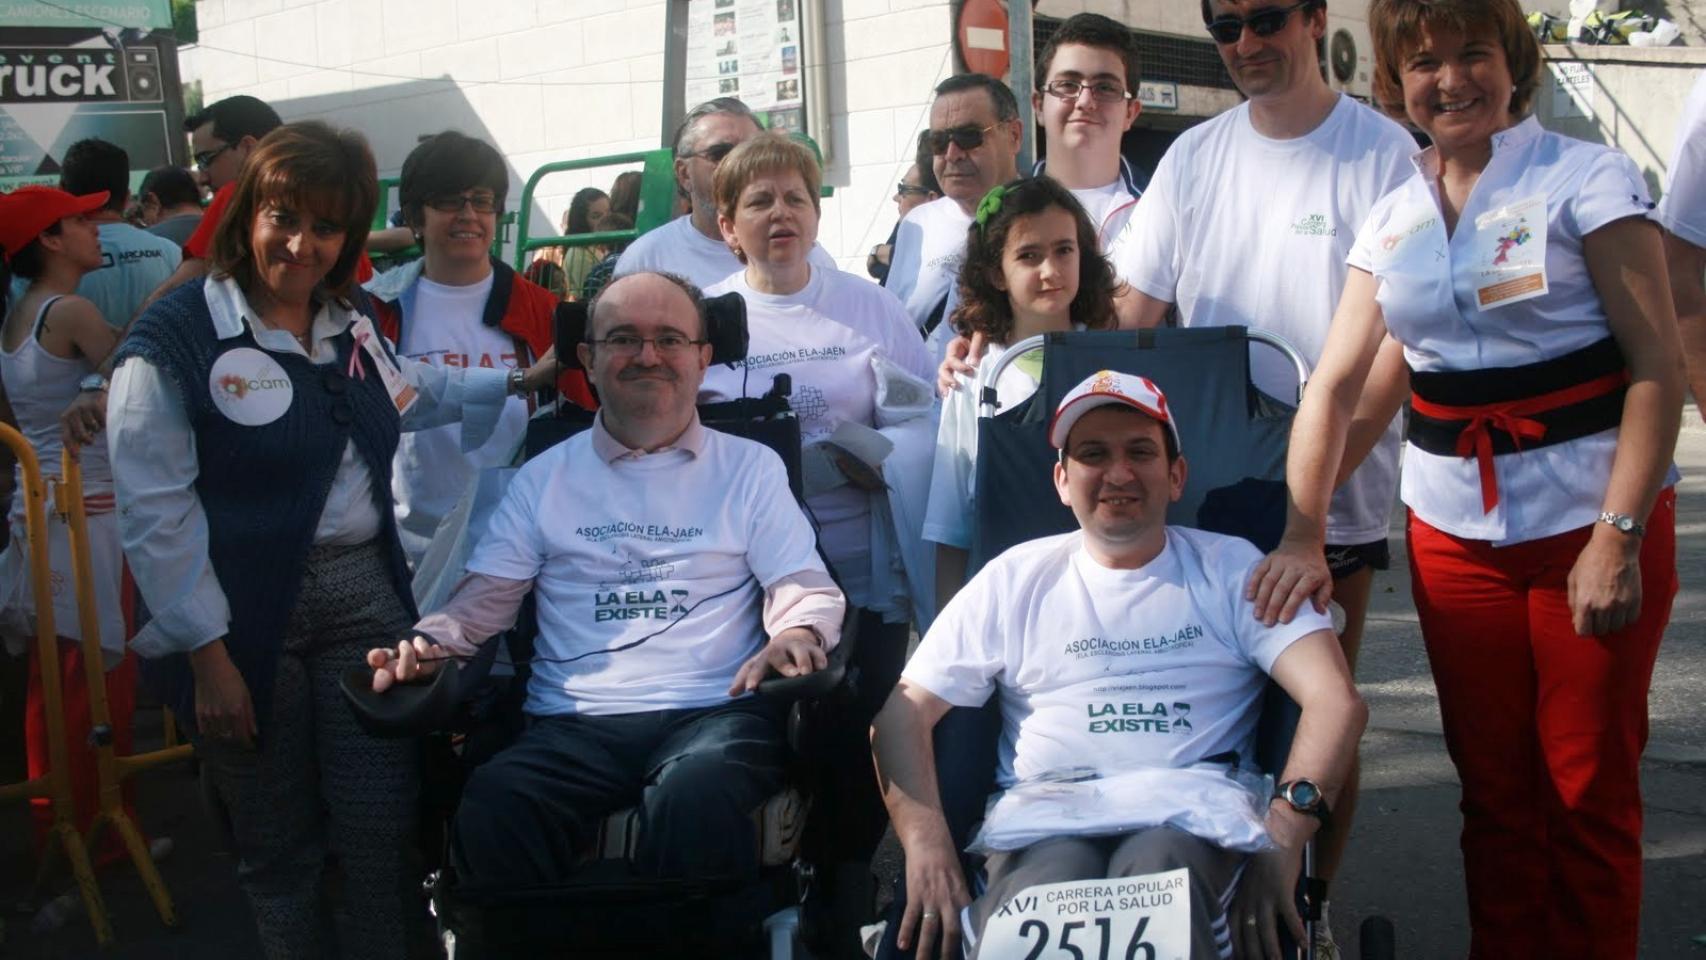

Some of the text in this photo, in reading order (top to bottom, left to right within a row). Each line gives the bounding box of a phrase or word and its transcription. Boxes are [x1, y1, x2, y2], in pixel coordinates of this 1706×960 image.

[736, 346, 846, 369] ASOCIACIÓN ELA-JAÉN
[576, 522, 703, 539] ASOCIACIÓN ELA-JAÉN
[595, 590, 667, 606] LA ELA
[595, 606, 668, 622] EXISTE
[1064, 624, 1204, 655] ASOCIACIÓN ELA-JAÉN
[1088, 702, 1168, 717] LA ELA
[1088, 719, 1170, 733] EXISTE
[997, 877, 1184, 918] XVI CARRERA POPULAR
[1057, 893, 1173, 915] POR LA SALUD
[1018, 916, 1156, 960] 2516
